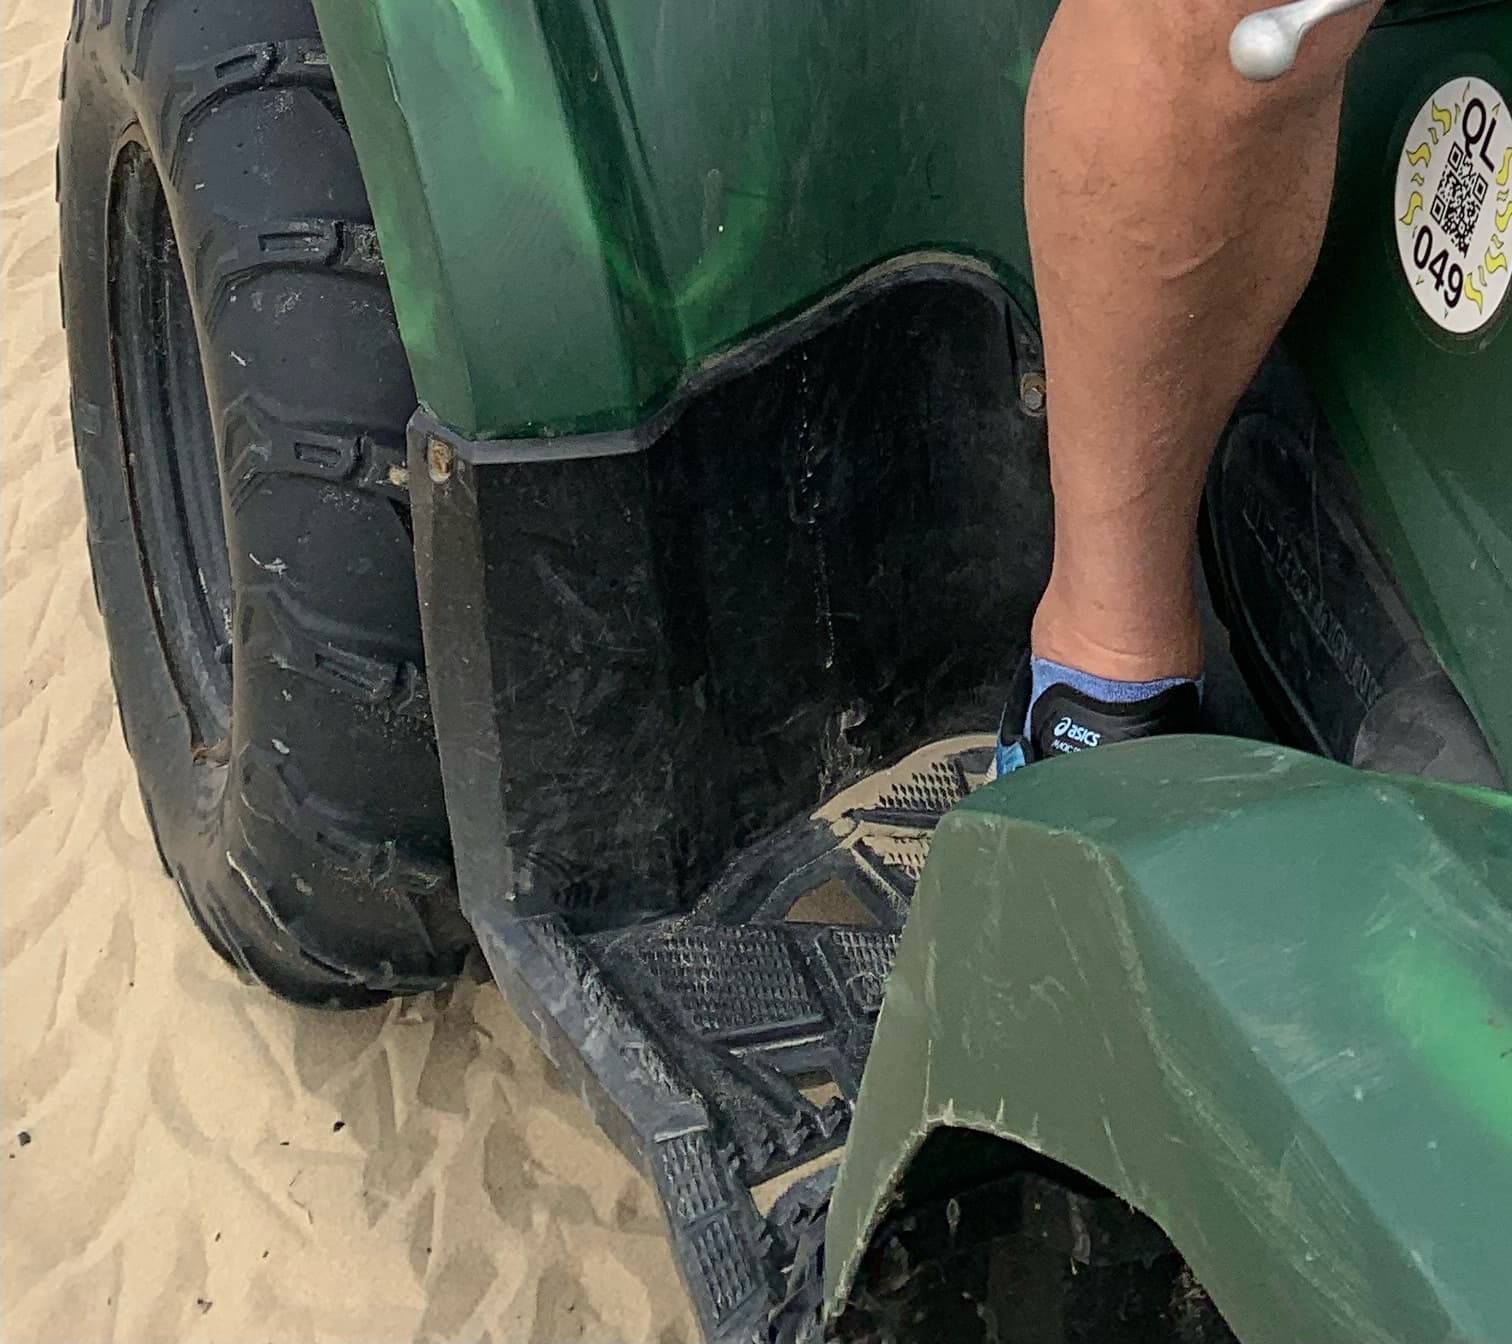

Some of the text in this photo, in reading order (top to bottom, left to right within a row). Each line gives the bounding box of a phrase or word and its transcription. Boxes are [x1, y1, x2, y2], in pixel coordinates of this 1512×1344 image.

[1462, 97, 1497, 173] QL
[1413, 224, 1464, 309] 049
[1067, 724, 1101, 747] asics
